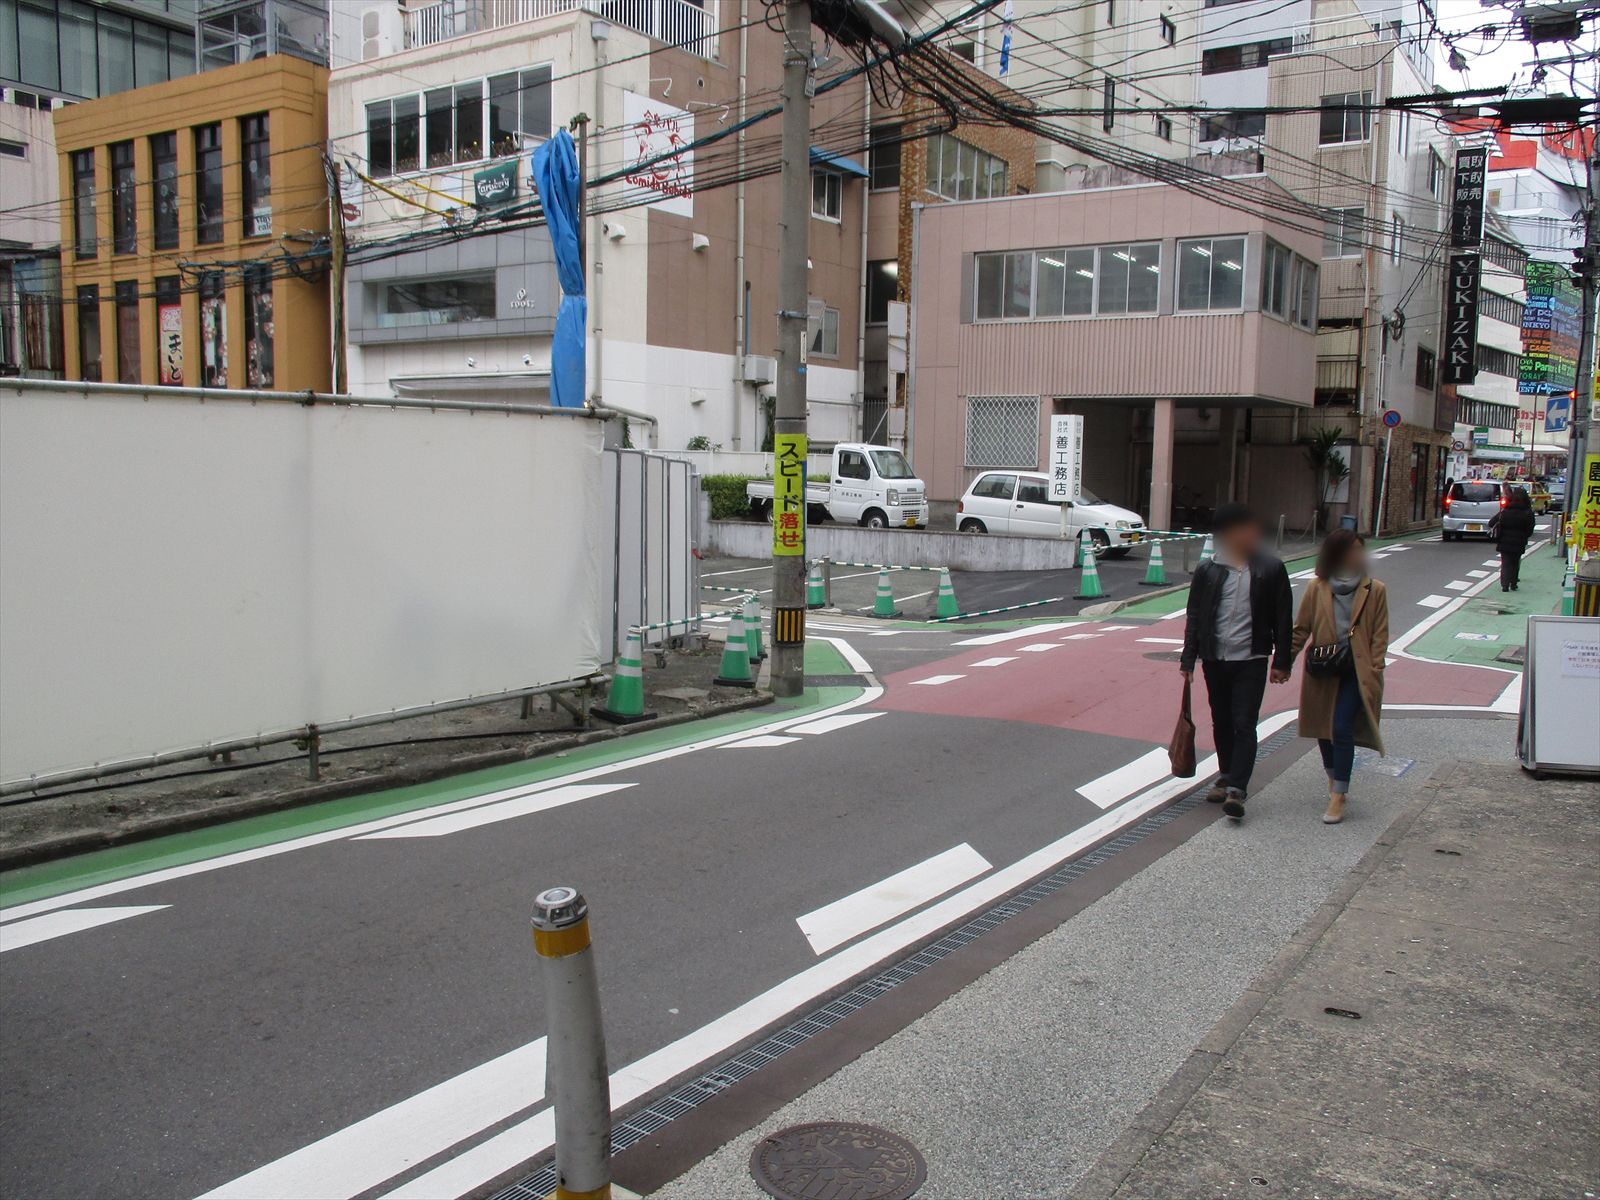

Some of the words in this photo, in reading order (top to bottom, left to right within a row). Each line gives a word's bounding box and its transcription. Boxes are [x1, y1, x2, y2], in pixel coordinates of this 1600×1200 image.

[478, 173, 510, 197] Carlsberg
[1451, 260, 1474, 379] YUKIZAKI
[779, 442, 800, 548] スピード落せ
[1054, 436, 1069, 496] 善工務店
